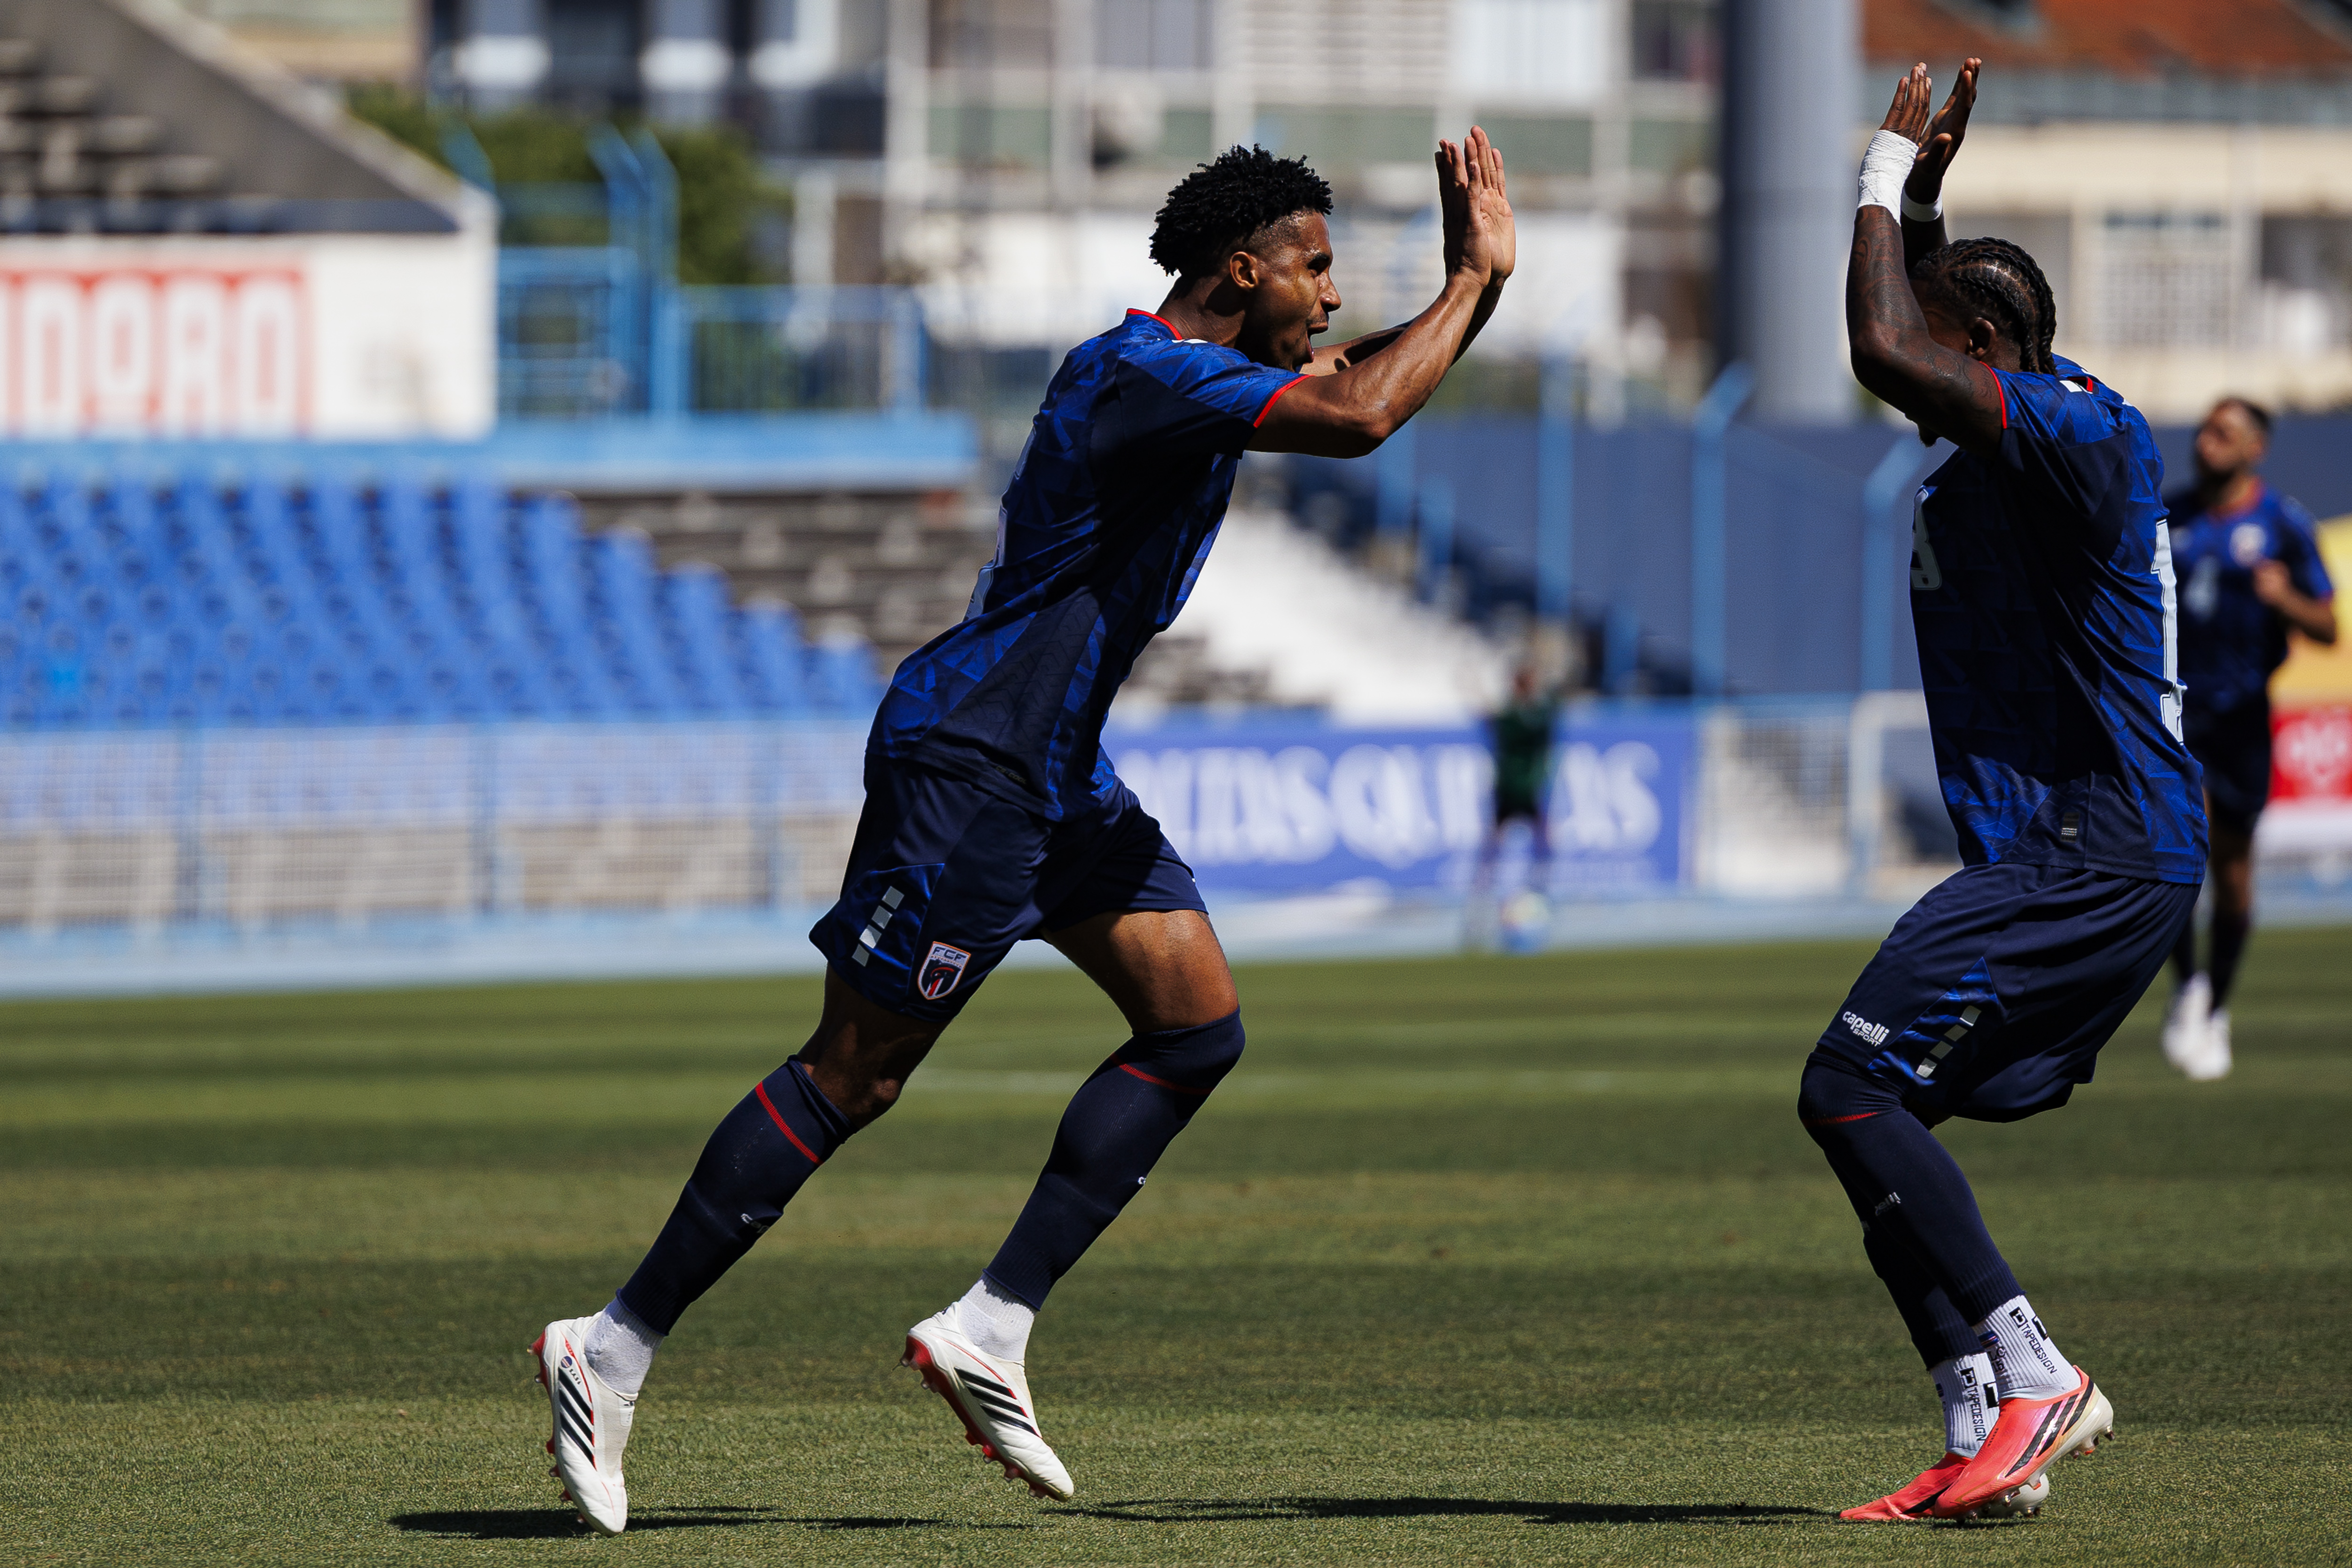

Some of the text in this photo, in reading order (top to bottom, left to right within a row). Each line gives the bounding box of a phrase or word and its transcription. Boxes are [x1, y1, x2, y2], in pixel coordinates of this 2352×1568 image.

[932, 947, 967, 961] FCF
[1843, 1011, 1890, 1043] capelli
[1852, 1028, 1881, 1047] SPORT
[2021, 1322, 2058, 1374] TAPEDESIGN
[1967, 1387, 1986, 1441] TAPEDESIGN
